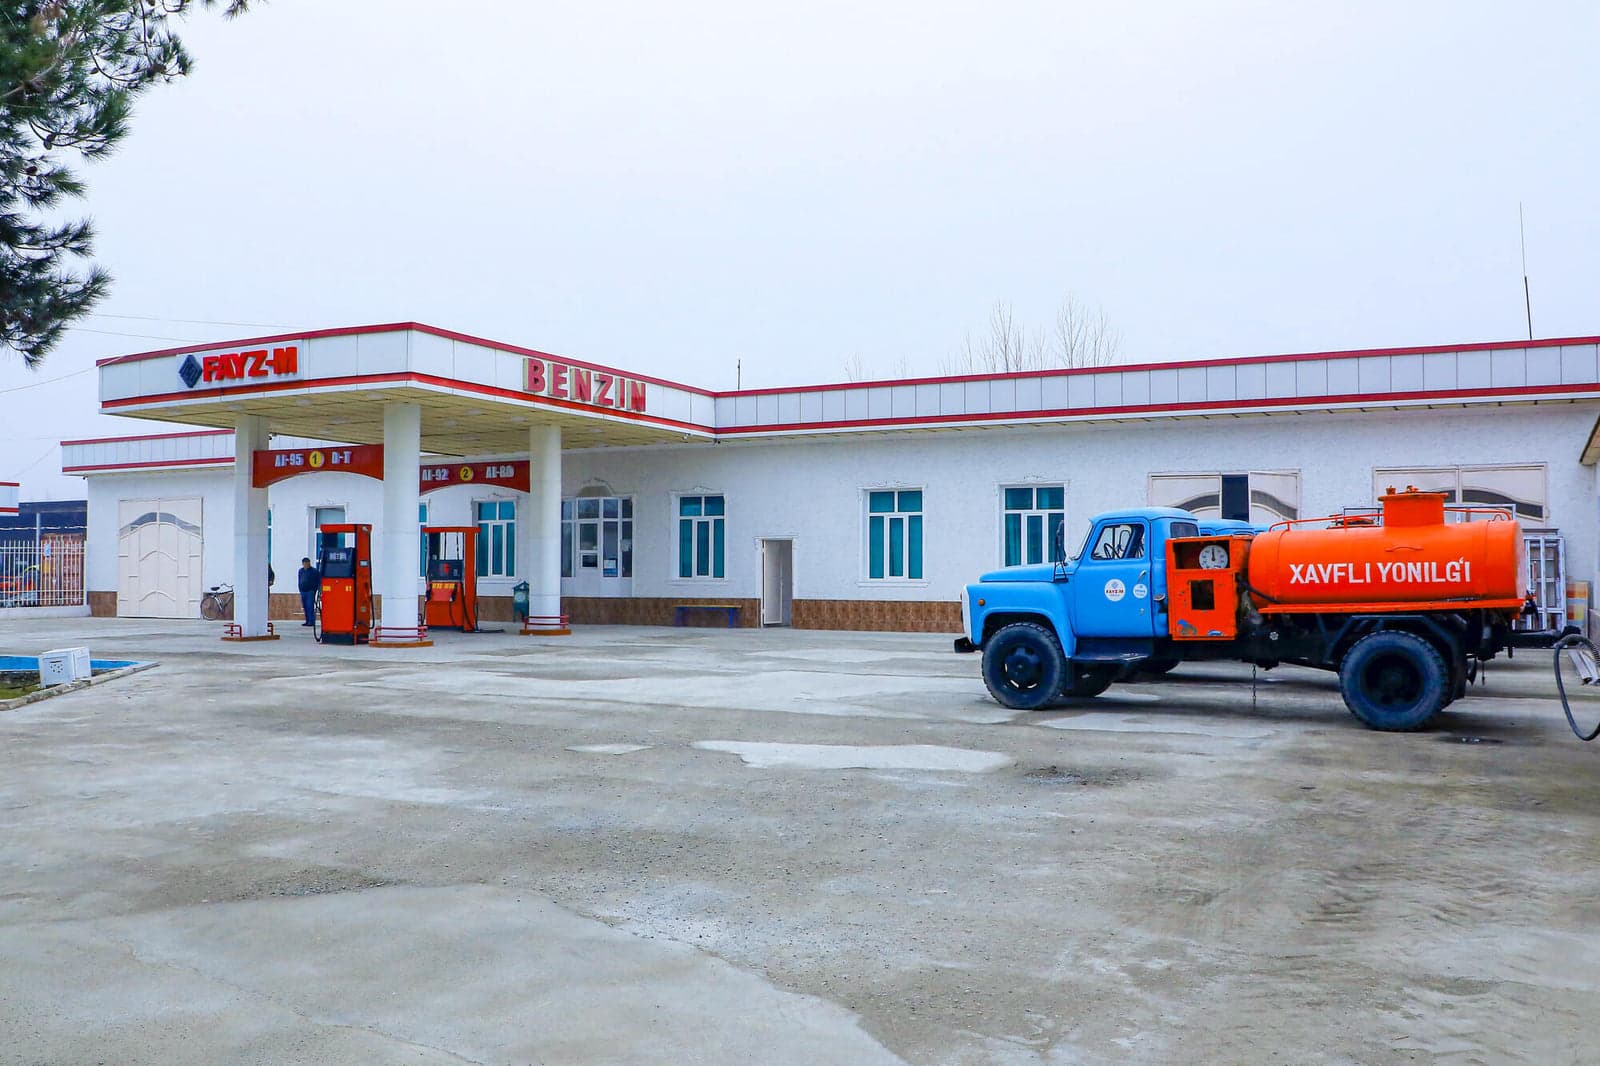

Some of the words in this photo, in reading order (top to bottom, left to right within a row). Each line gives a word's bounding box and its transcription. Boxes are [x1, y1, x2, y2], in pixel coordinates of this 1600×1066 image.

[203, 347, 297, 382] FAYZ-M
[523, 358, 646, 412] BENZIN
[1289, 563, 1371, 584] XAVFLI
